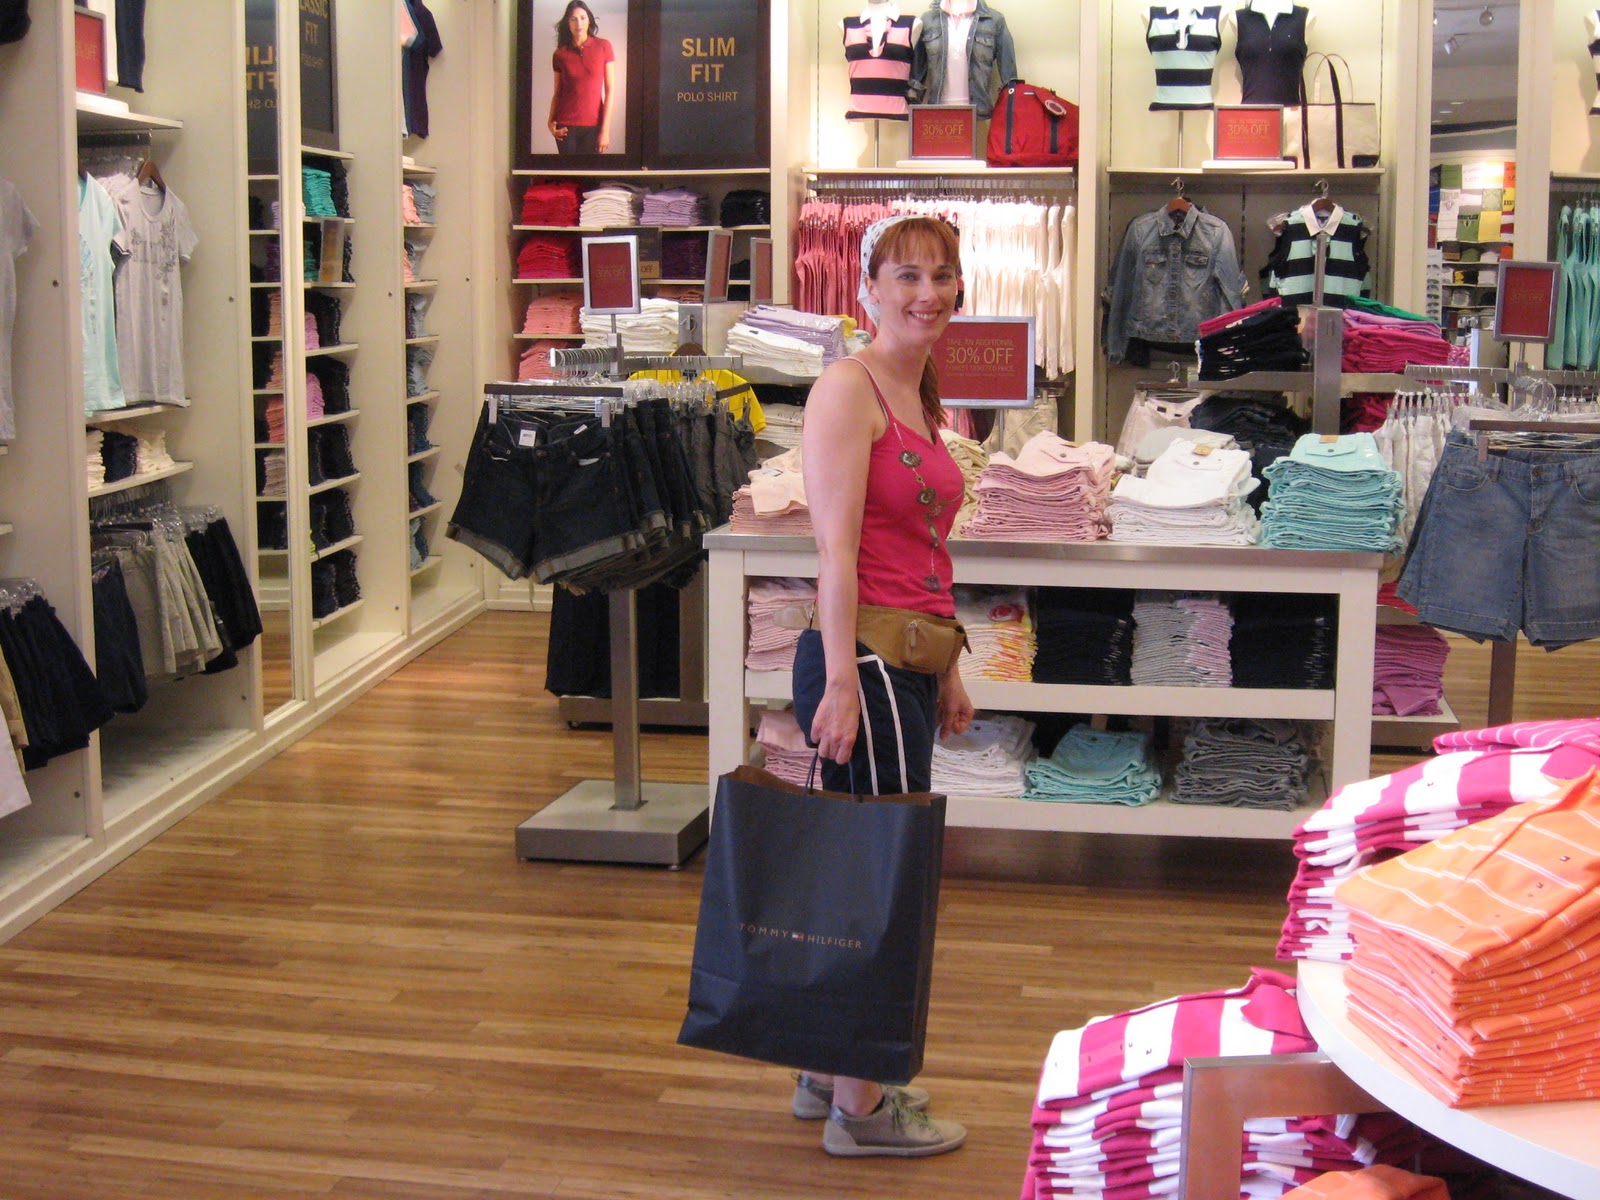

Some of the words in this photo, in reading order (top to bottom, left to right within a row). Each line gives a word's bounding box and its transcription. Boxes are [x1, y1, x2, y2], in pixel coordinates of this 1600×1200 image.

[299, 0, 329, 19] LASSIC
[304, 20, 319, 45] FIT
[681, 36, 736, 57] SLIM
[691, 63, 725, 83] FIT
[677, 91, 705, 102] POLO
[707, 91, 738, 102] SHIRT
[922, 124, 944, 136] 30%
[945, 124, 964, 135] OFF
[1227, 124, 1249, 136] 30%
[1250, 124, 1270, 135] OFF
[641, 265, 653, 273] OFF
[945, 347, 980, 364] 30%
[983, 347, 1014, 364] OFF
[739, 922, 789, 938] TOMMY
[807, 934, 862, 949] HILFIGER
